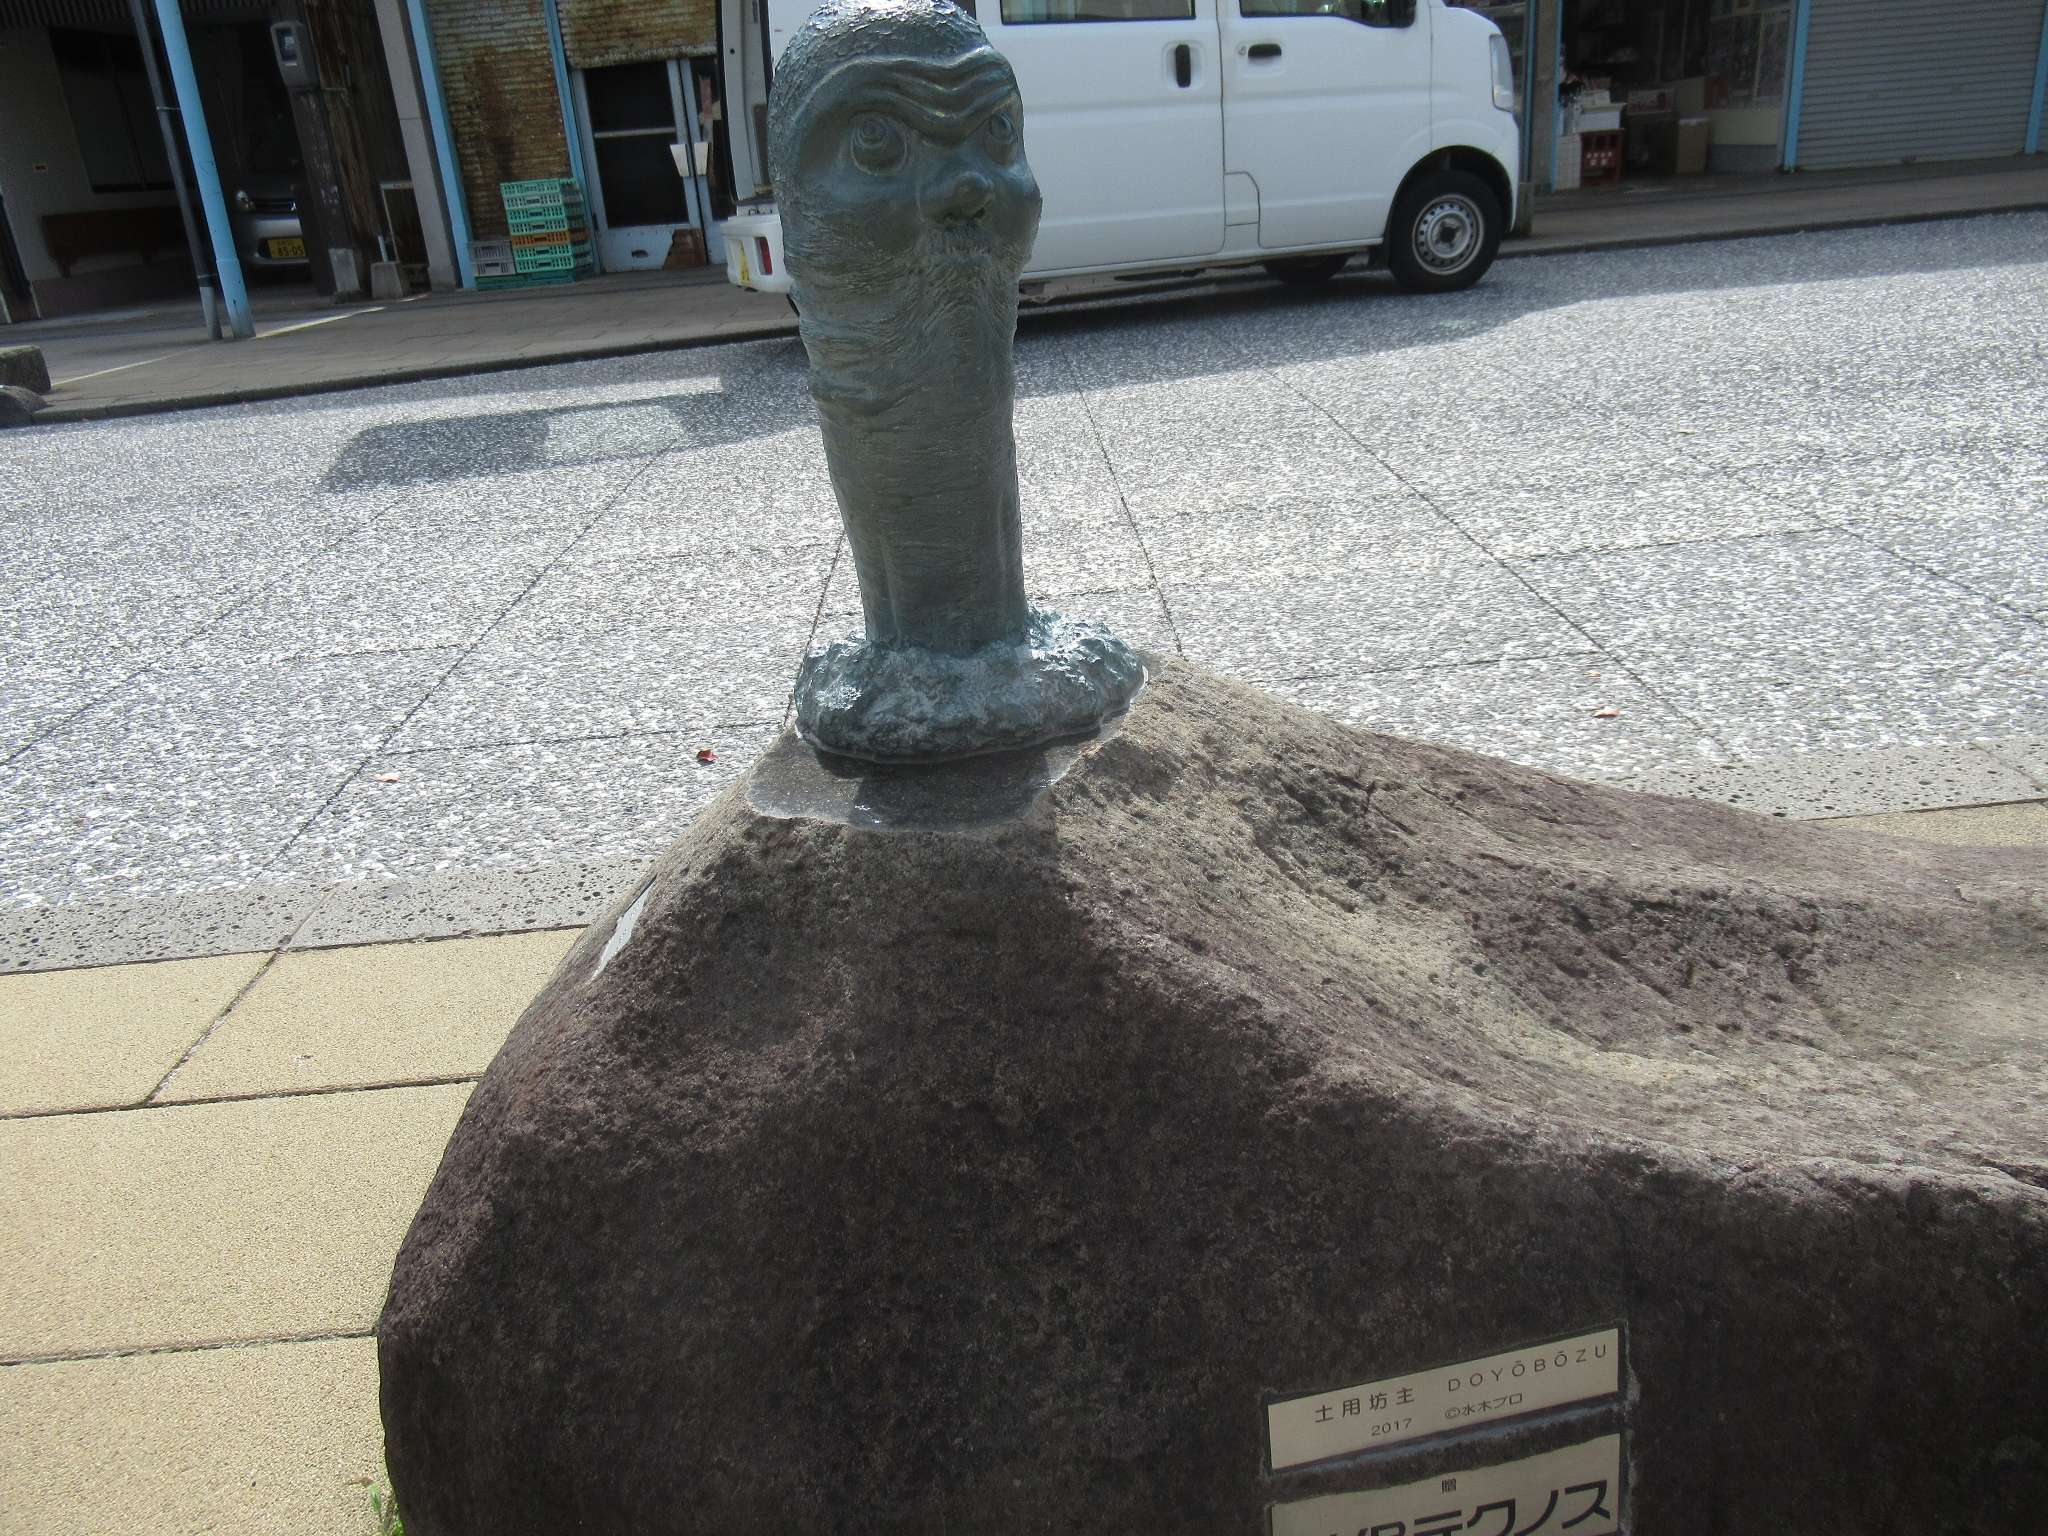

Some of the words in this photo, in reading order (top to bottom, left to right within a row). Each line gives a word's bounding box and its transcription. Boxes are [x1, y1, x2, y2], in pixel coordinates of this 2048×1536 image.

[1315, 1387, 1415, 1423] 土用坊主
[1371, 1418, 1412, 1436] 2017
